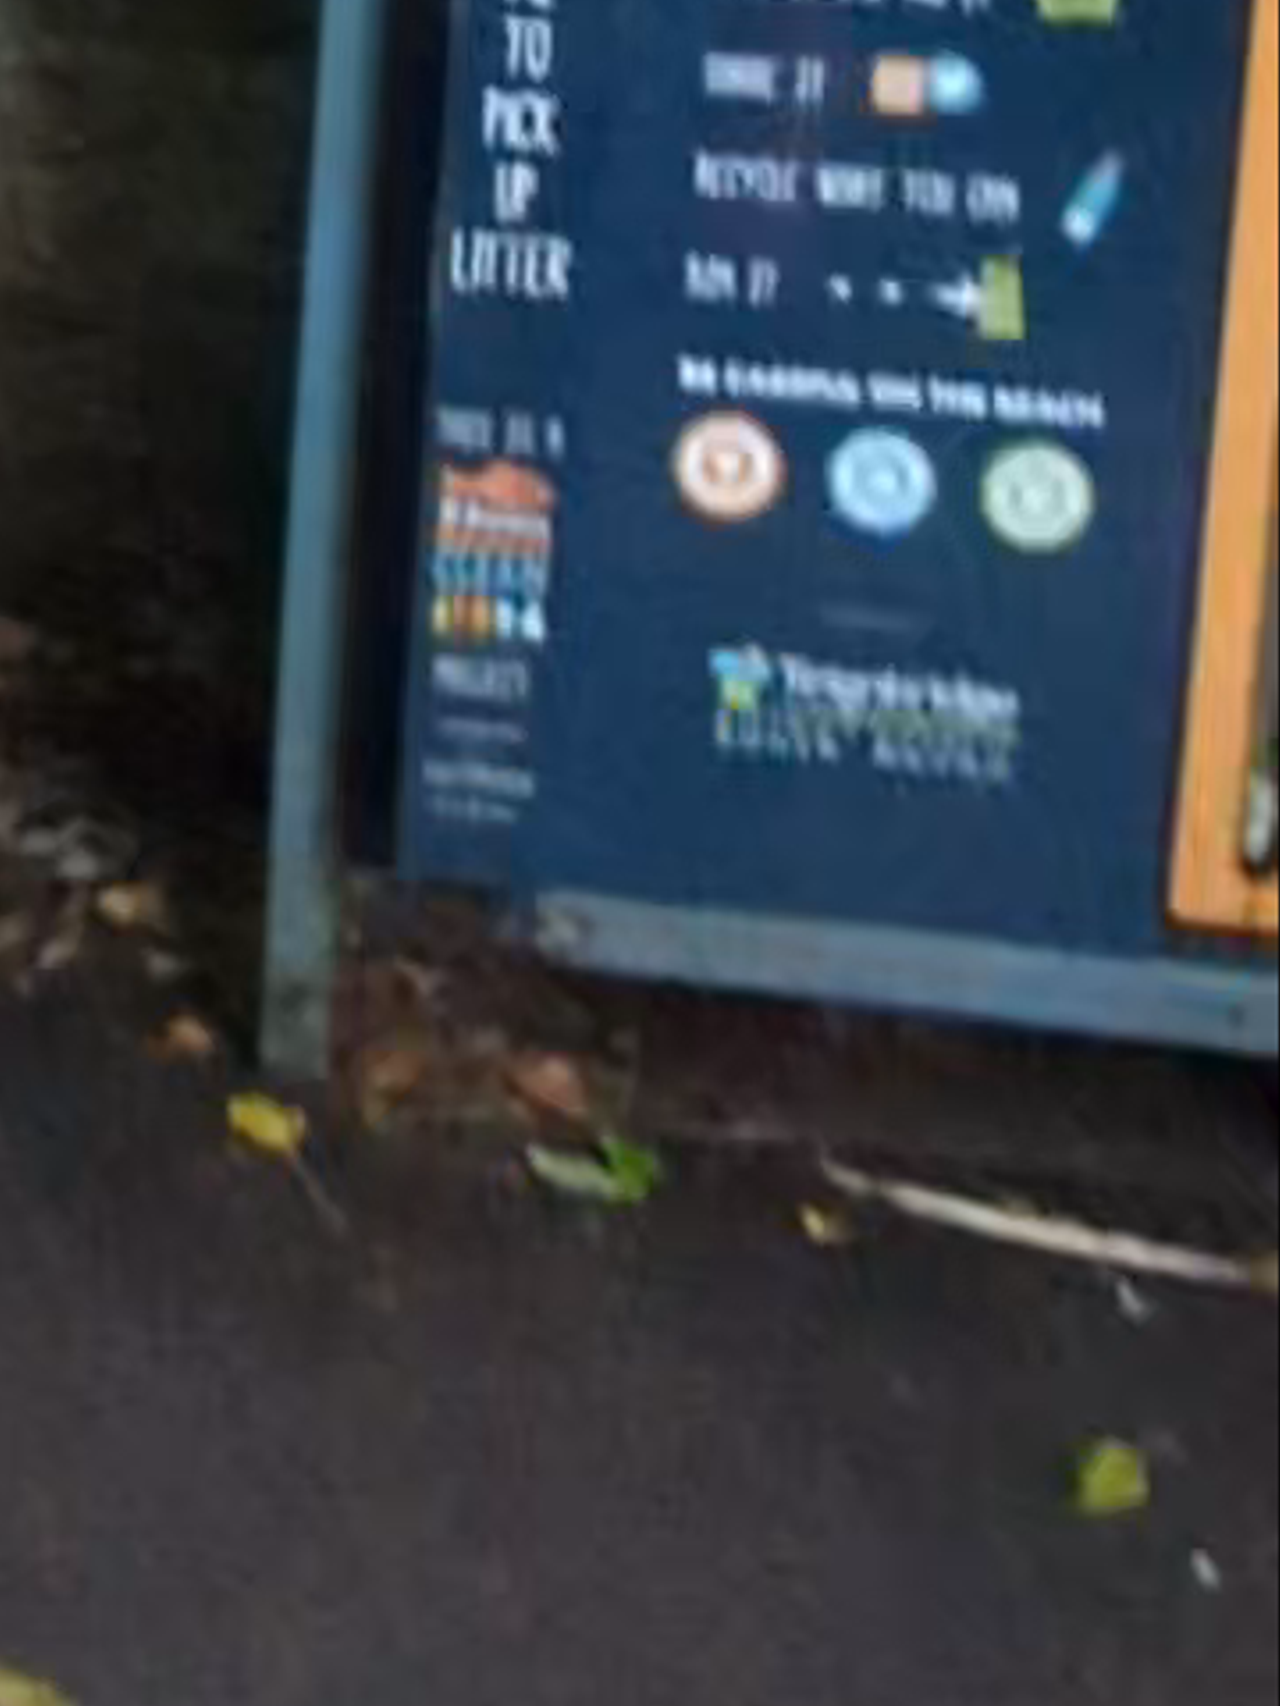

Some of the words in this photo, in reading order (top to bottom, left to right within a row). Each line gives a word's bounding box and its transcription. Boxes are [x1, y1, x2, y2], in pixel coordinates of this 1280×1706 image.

[505, 14, 554, 83] TO
[482, 85, 562, 156] PICK
[495, 160, 539, 224] UP
[451, 228, 574, 300] LITTER
